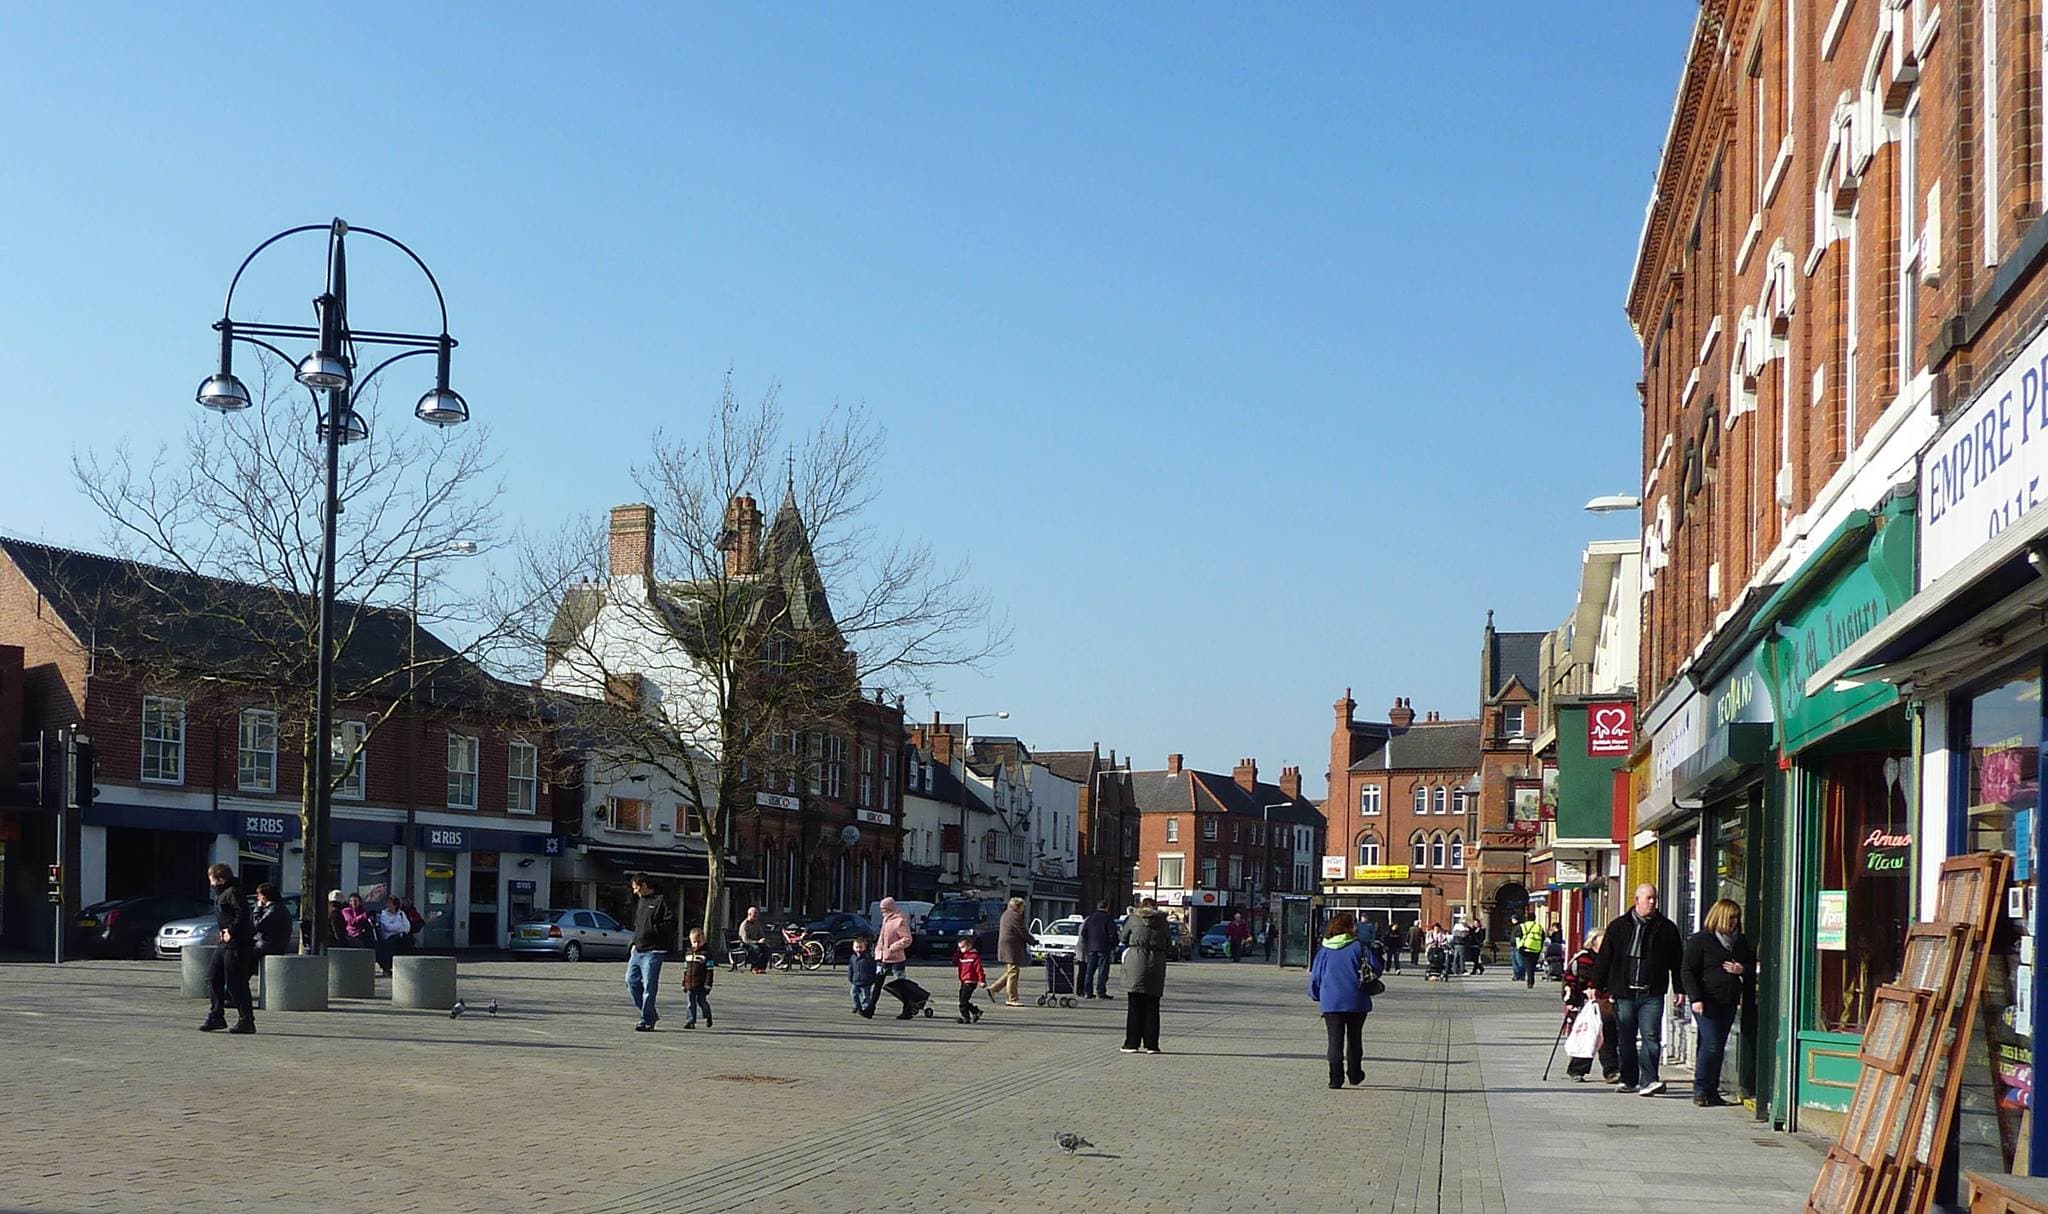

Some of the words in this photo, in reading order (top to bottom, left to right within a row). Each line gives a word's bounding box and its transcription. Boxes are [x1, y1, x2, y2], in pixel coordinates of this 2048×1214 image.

[1930, 390, 2013, 526] EMPIRE
[260, 818, 284, 833] RBS
[442, 831, 462, 845] RBS
